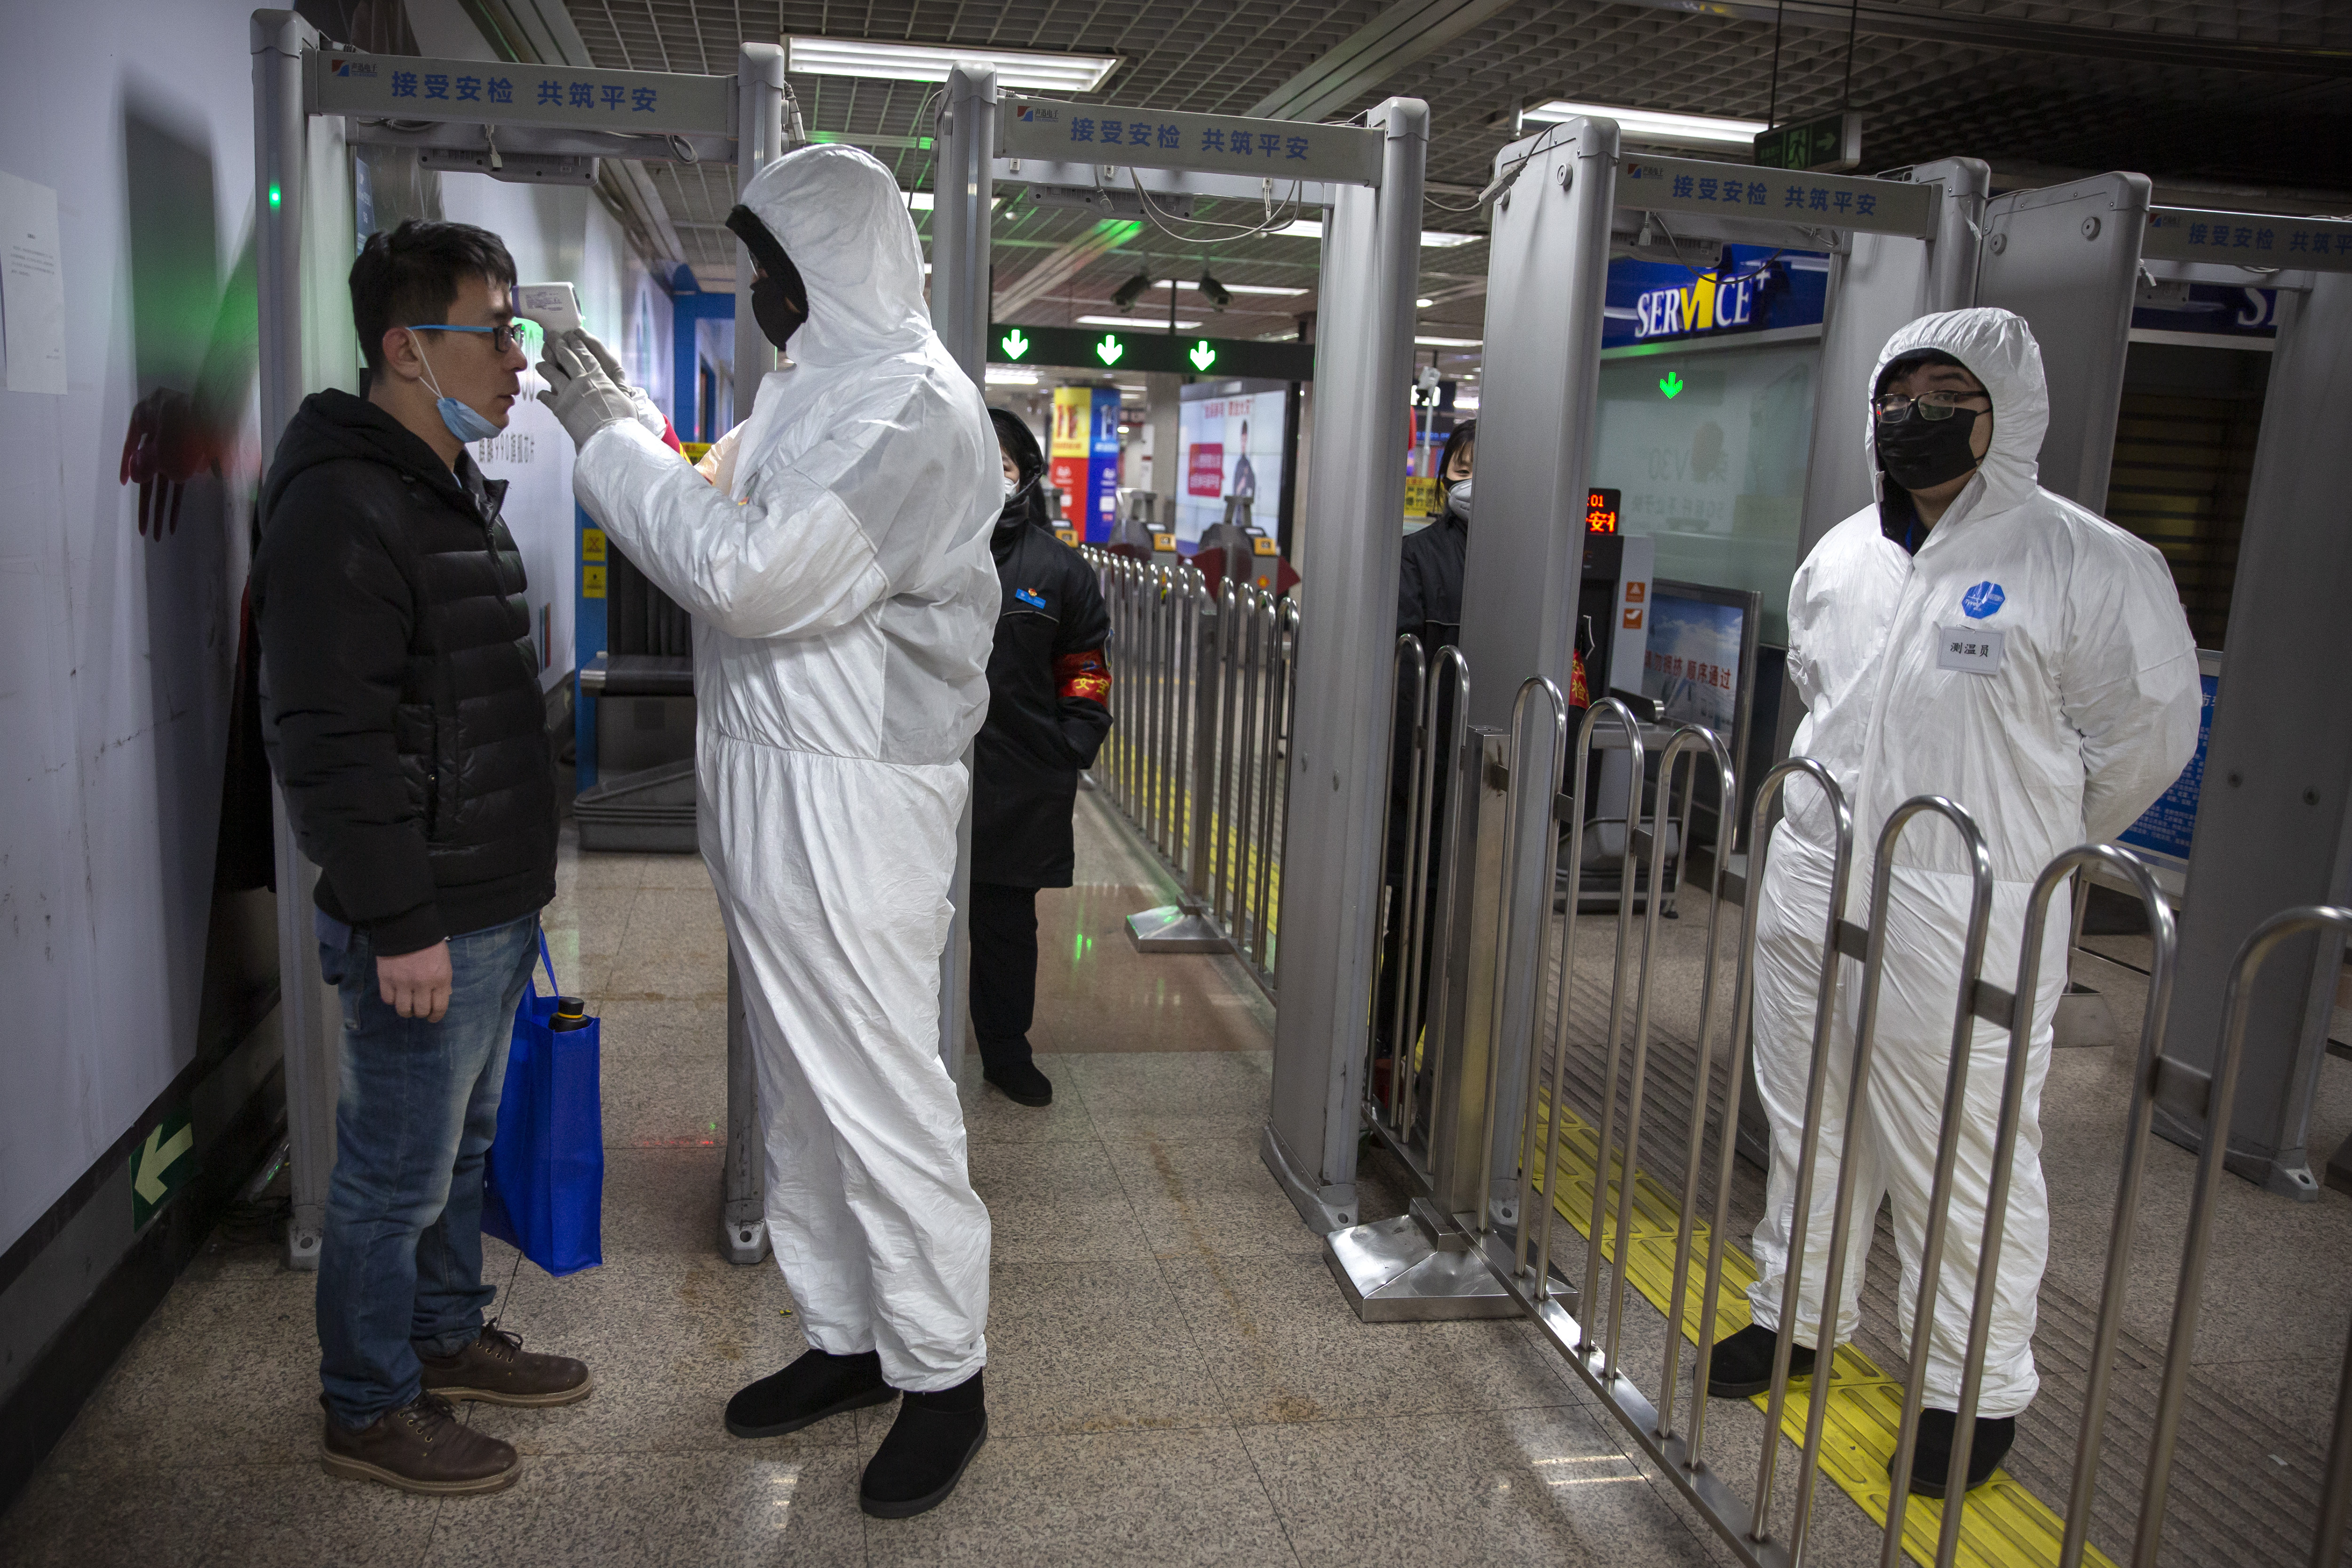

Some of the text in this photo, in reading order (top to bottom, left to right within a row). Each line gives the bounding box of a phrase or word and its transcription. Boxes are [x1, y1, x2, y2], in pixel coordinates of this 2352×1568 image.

[391, 71, 657, 112] 接受安检 共筑平安
[1071, 117, 1309, 160] 接受安检 共筑平安
[1672, 174, 1876, 216] 接受安检 共筑平安
[2188, 222, 2274, 250] 接受安检
[1950, 642, 1989, 657] 测温员
[1686, 659, 1731, 689] 顺序通过
